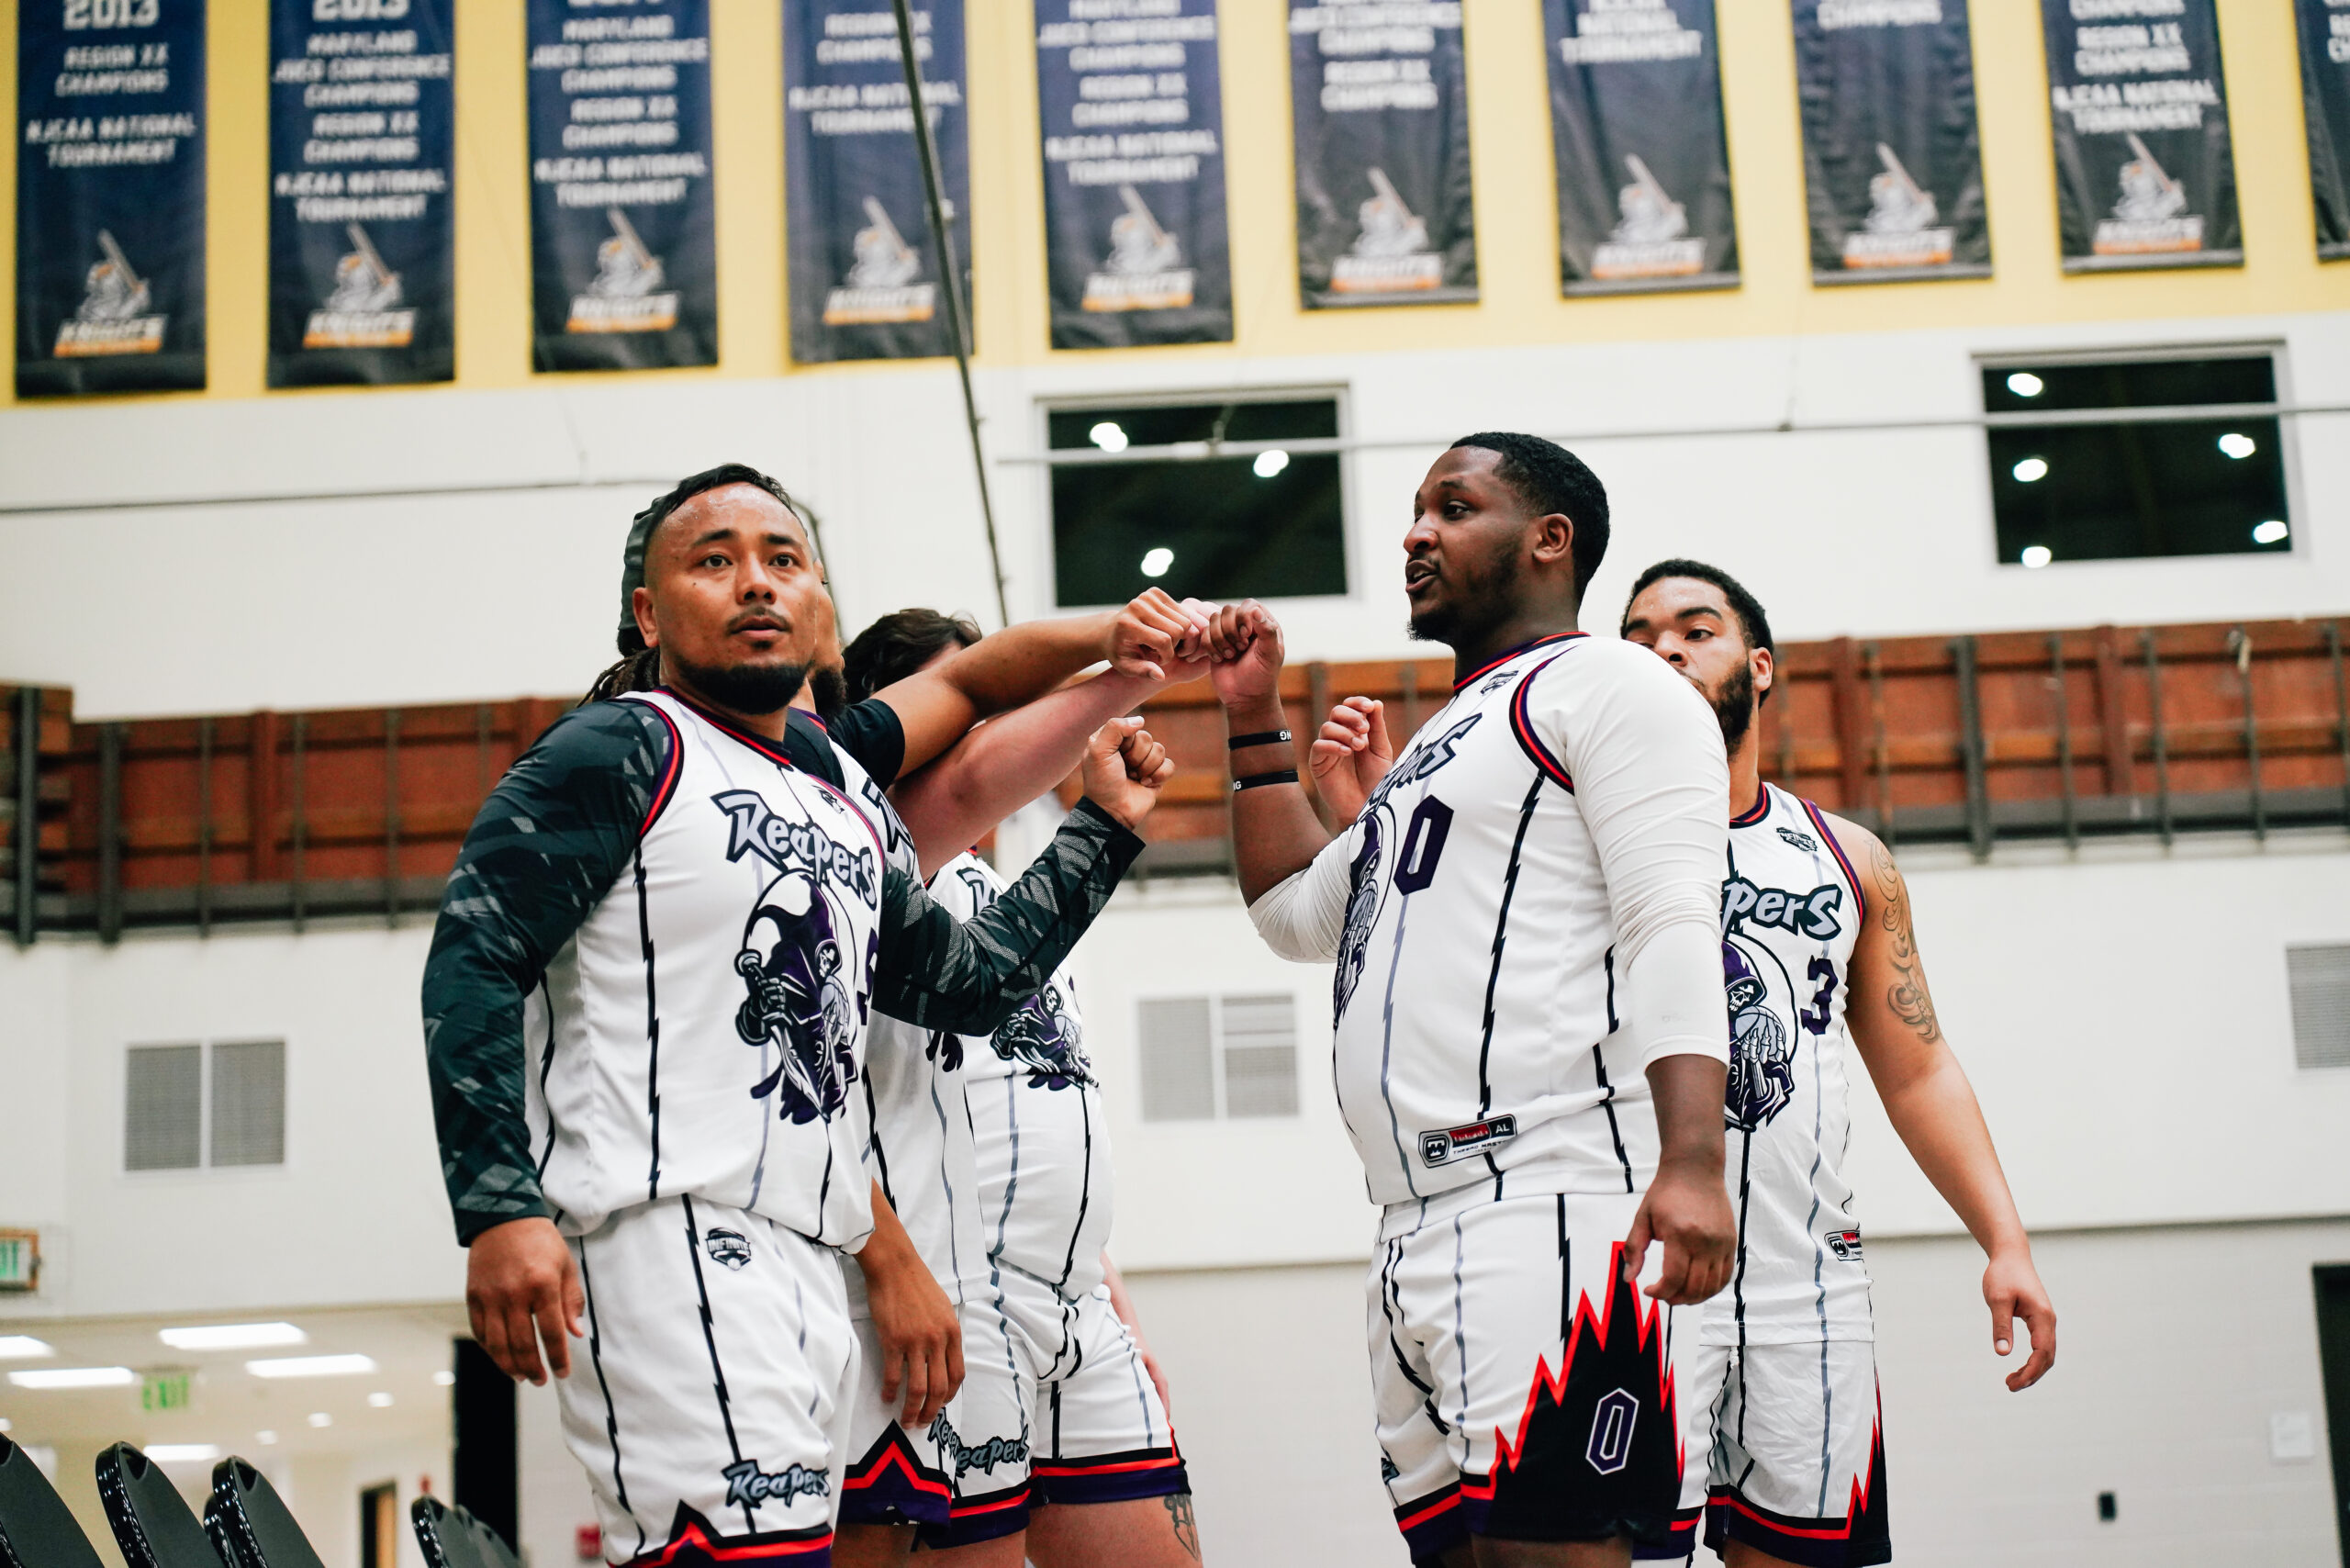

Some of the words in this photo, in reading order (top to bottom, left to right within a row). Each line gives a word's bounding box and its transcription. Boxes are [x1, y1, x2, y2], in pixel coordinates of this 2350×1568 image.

[64, 45, 135, 70] REGION
[55, 68, 169, 96] CHAMPIONS
[304, 80, 420, 107] CHAMPIONS
[98, 112, 196, 140] NATIONAL
[49, 139, 176, 168] TOURNAMENT
[303, 138, 420, 163] CHAMPIONS
[296, 193, 427, 222] TOURNAMENT
[711, 788, 878, 912] Reapers
[1393, 794, 1454, 896] 0
[1799, 954, 1839, 1036] 3
[1495, 1123, 1510, 1135] AL
[1585, 1387, 1639, 1475] 0
[955, 1423, 1030, 1479] eapers
[720, 1458, 830, 1509] Reapers
